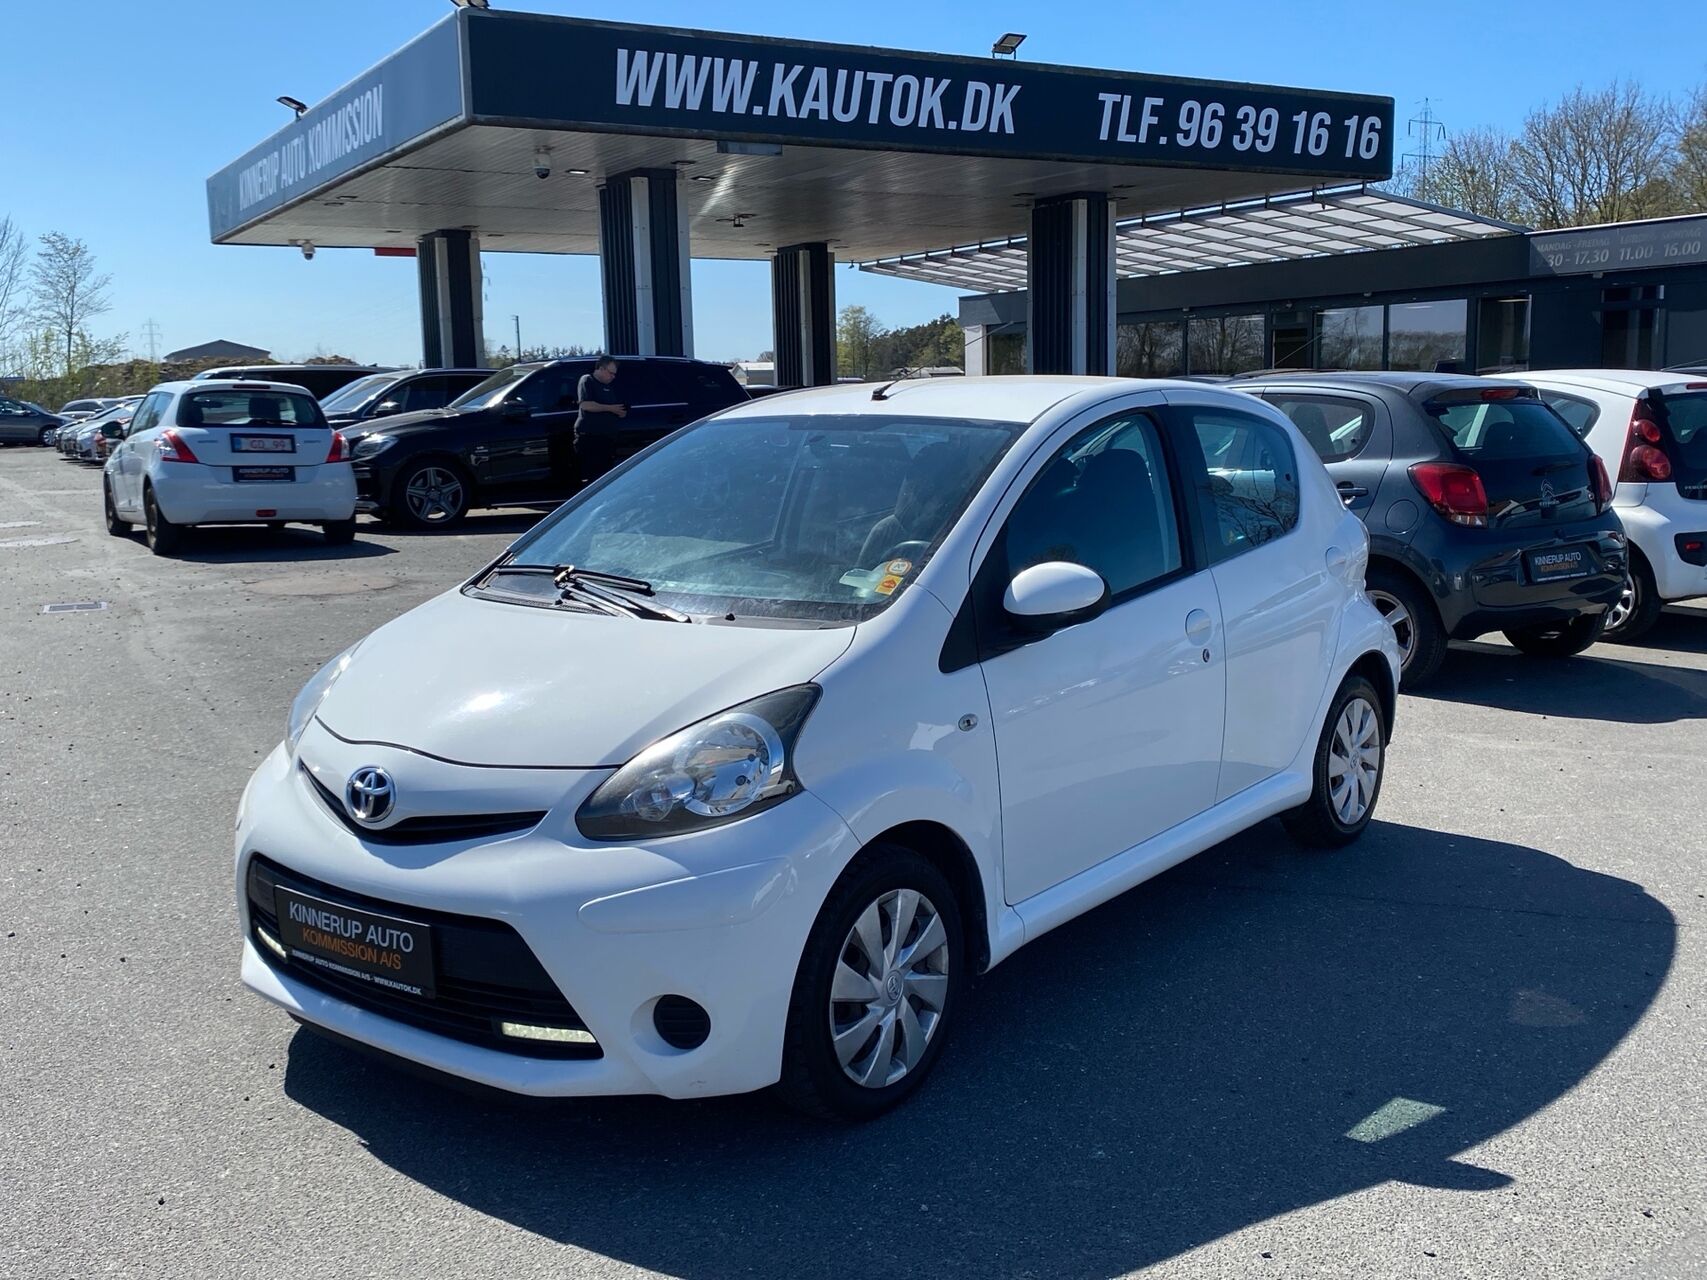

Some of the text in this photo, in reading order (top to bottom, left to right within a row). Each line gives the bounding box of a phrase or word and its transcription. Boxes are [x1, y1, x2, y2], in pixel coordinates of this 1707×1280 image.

[615, 48, 1022, 134] WWW.KAUTOK.DK
[239, 84, 383, 211] KINNERUP AUTO KOMMISSION
[1098, 92, 1382, 160] TLF. 96 39 16 16
[1575, 249, 1610, 265] 17.30
[1619, 245, 1654, 261] 11.00
[1663, 240, 1702, 257] 16.00
[1534, 552, 1582, 566] KINNERUP AUTO
[289, 901, 414, 953] KINNERUP AUTO
[302, 928, 402, 970] KOMMISSION A/S
